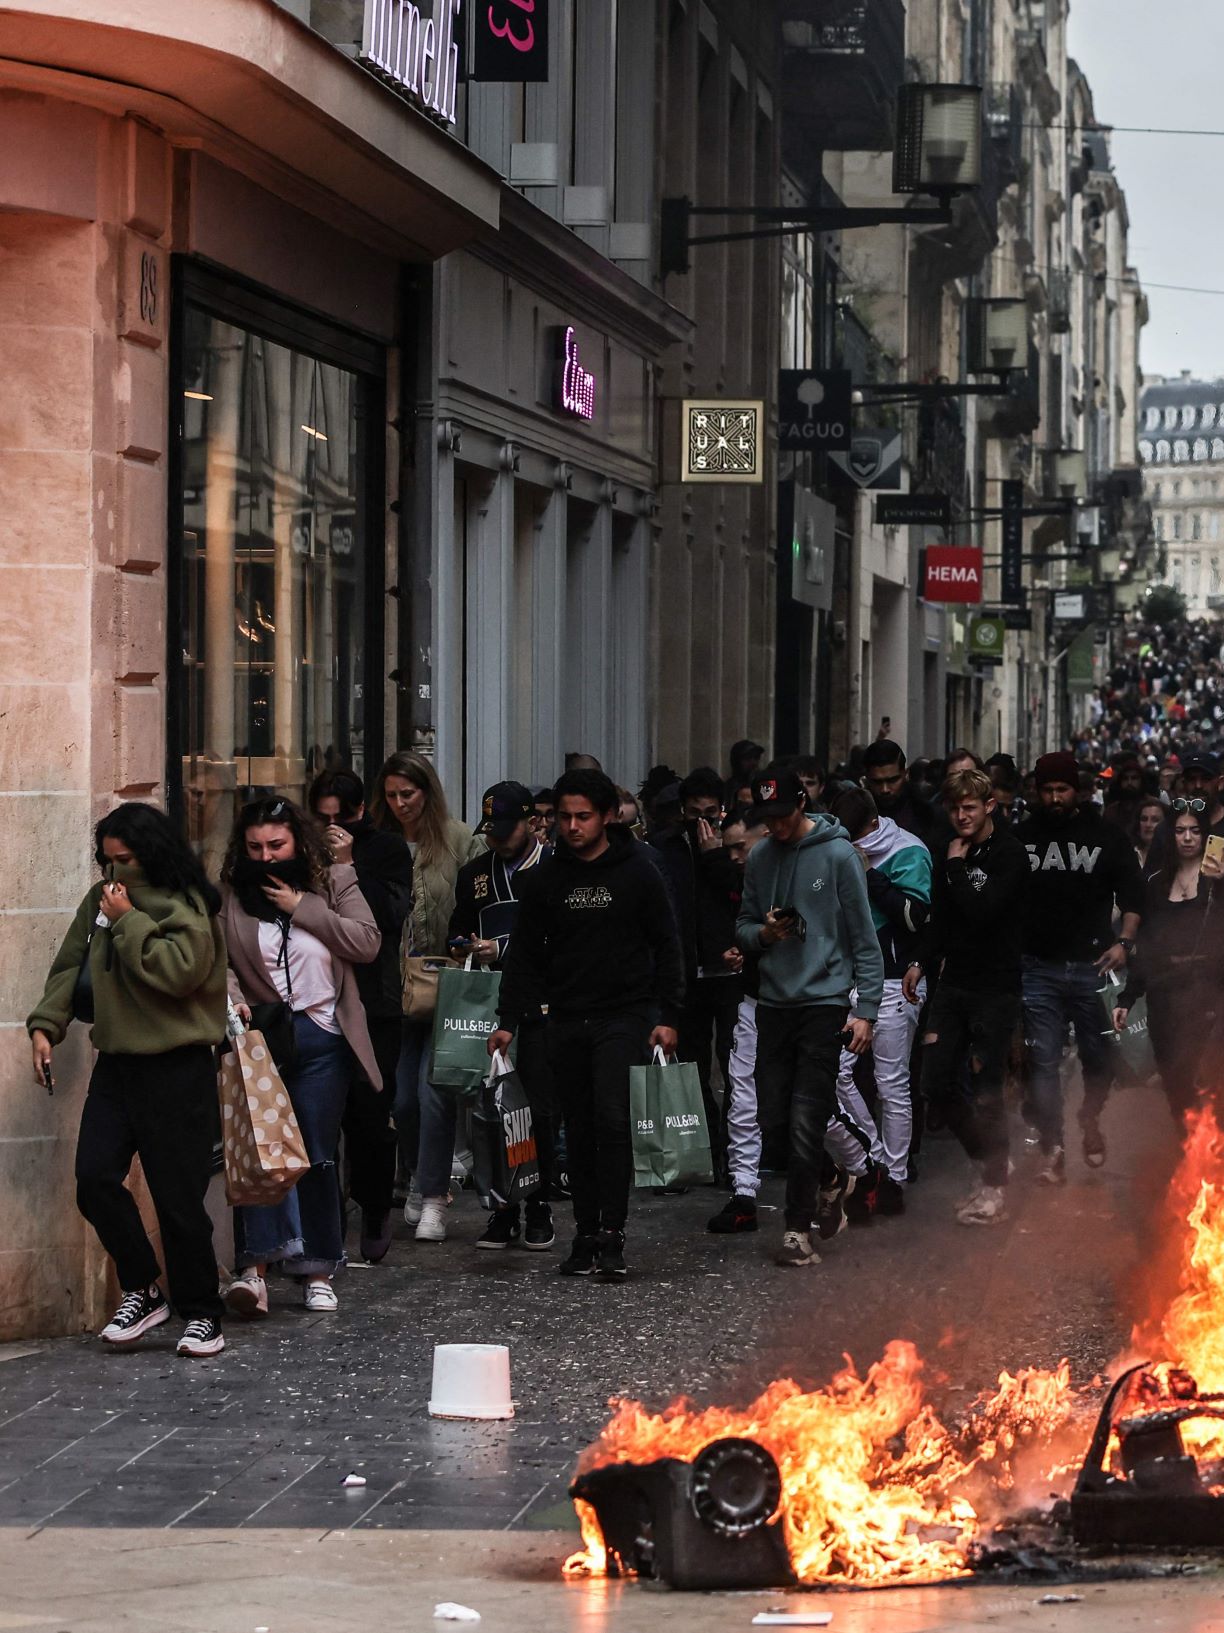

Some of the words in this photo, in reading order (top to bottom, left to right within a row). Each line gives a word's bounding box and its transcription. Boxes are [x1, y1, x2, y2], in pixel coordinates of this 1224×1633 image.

[927, 566, 978, 583] HEMA
[475, 883, 488, 899] 23
[443, 1018, 499, 1033] PULL&BEA
[637, 1120, 654, 1130] P&B
